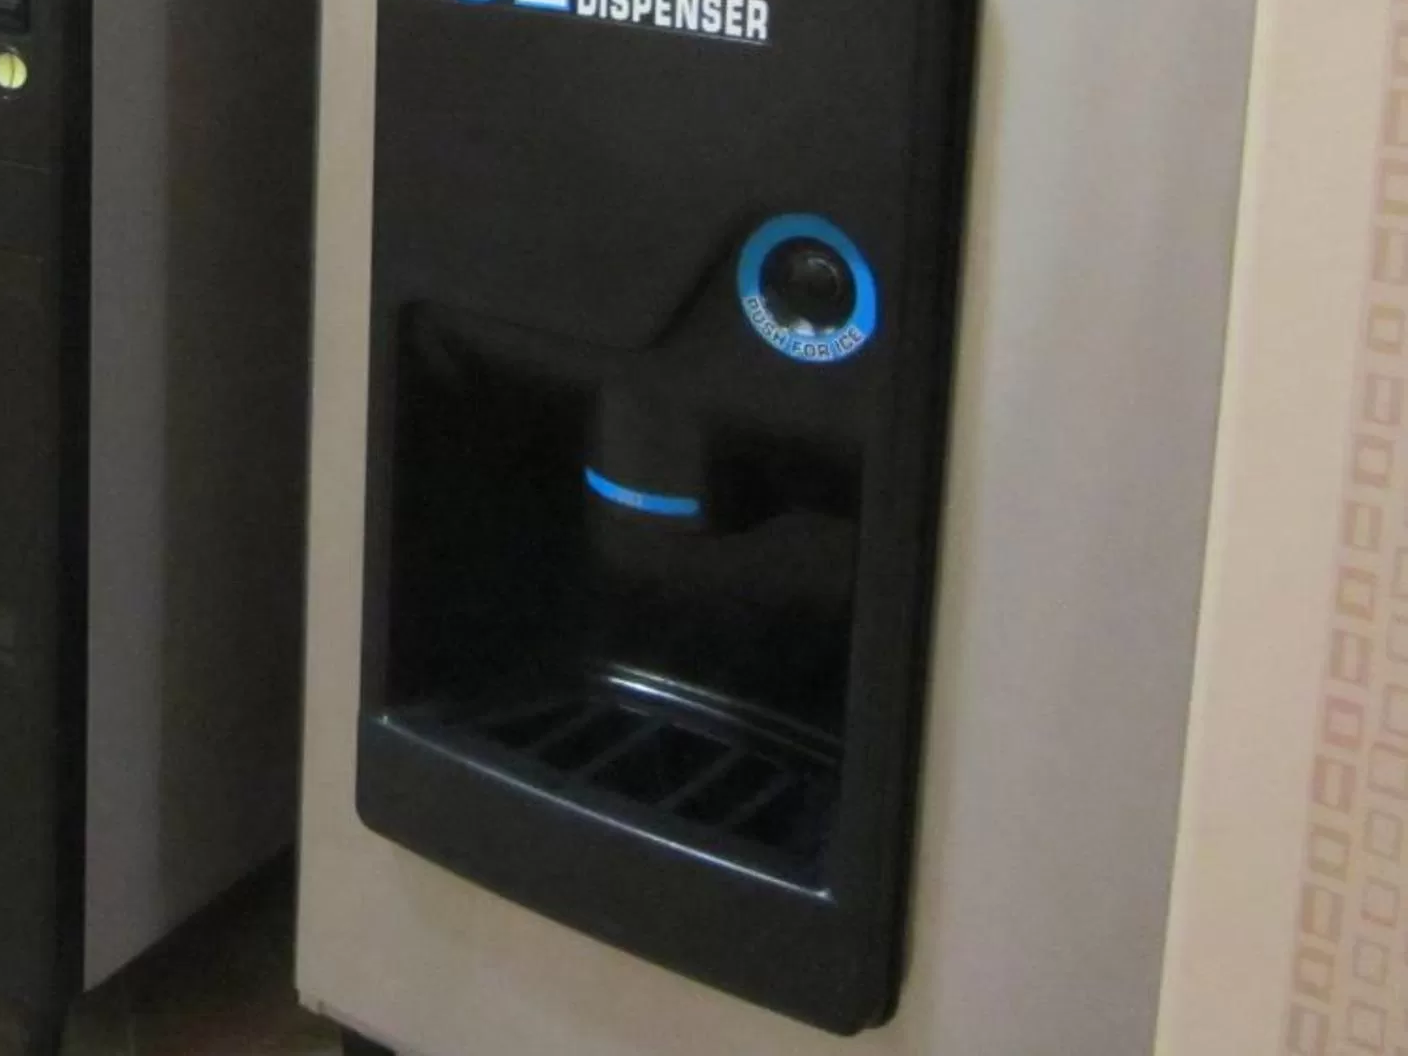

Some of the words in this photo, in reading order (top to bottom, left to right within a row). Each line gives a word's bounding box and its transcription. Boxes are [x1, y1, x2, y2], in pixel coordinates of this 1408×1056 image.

[746, 297, 789, 346] PUSH
[792, 341, 831, 359] FOR
[833, 326, 861, 354] ICE
